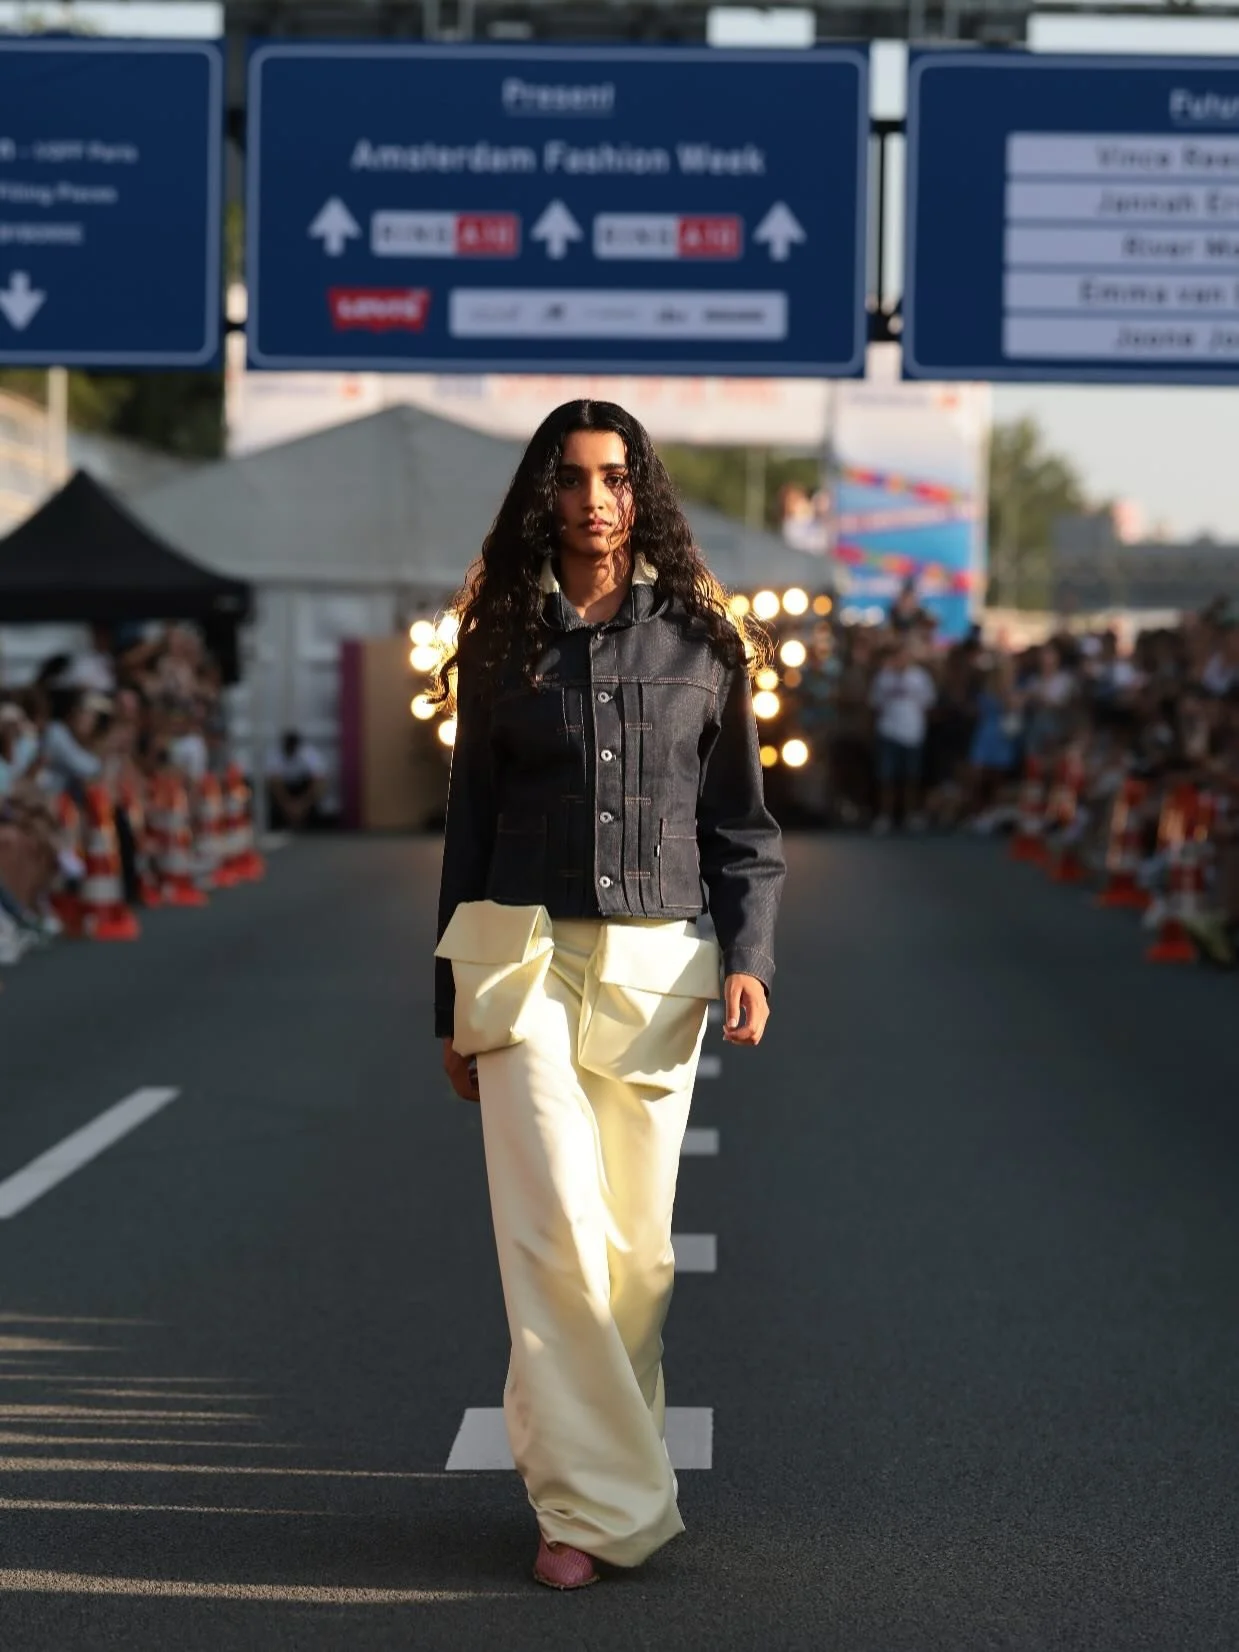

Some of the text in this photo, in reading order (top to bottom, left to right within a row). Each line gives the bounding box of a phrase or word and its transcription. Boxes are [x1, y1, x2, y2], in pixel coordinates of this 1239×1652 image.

[503, 80, 614, 107] Present
[352, 140, 765, 174] Amsterdam Fashion Week
[1096, 145, 1173, 169] Vince
[1080, 278, 1168, 305] Emma
